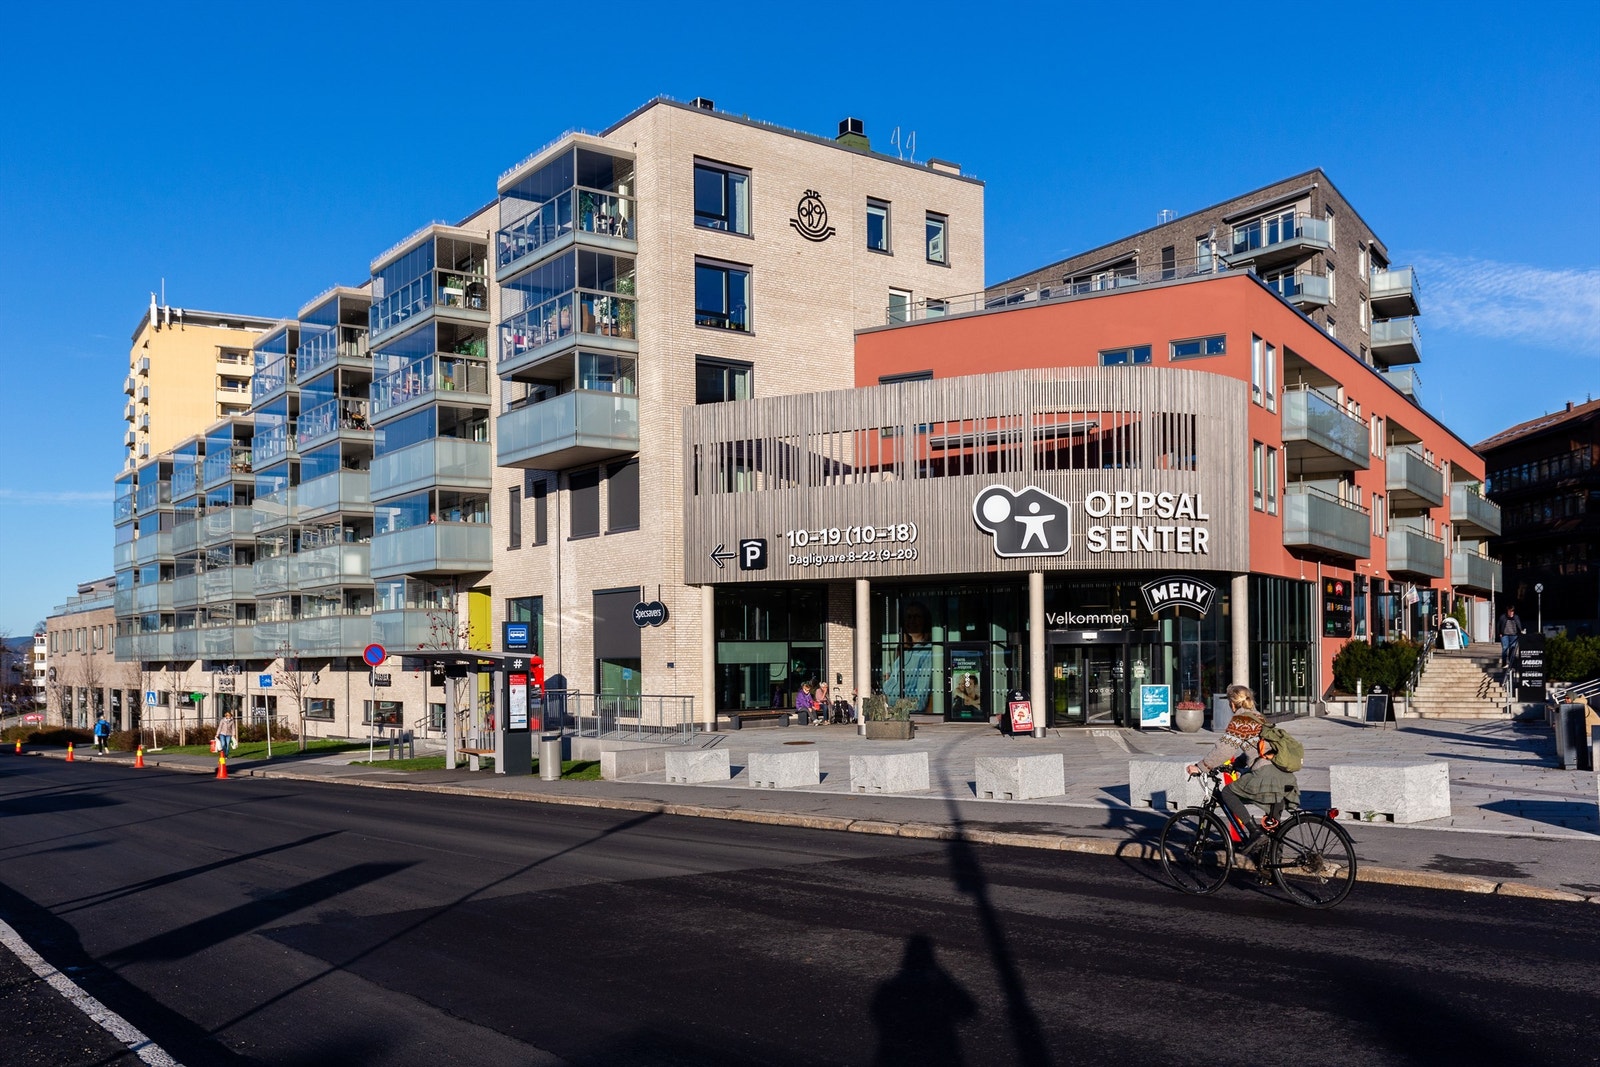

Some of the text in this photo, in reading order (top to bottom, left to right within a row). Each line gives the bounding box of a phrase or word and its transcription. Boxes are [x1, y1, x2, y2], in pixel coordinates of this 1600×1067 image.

[1084, 490, 1209, 521] OPPSAL
[1086, 525, 1209, 554] SENTER
[746, 547, 761, 567] P
[788, 552, 845, 567] Dagligvare
[1151, 582, 1209, 604] MENY
[635, 608, 662, 620] Specsavers
[1046, 611, 1129, 625] Velkommen
